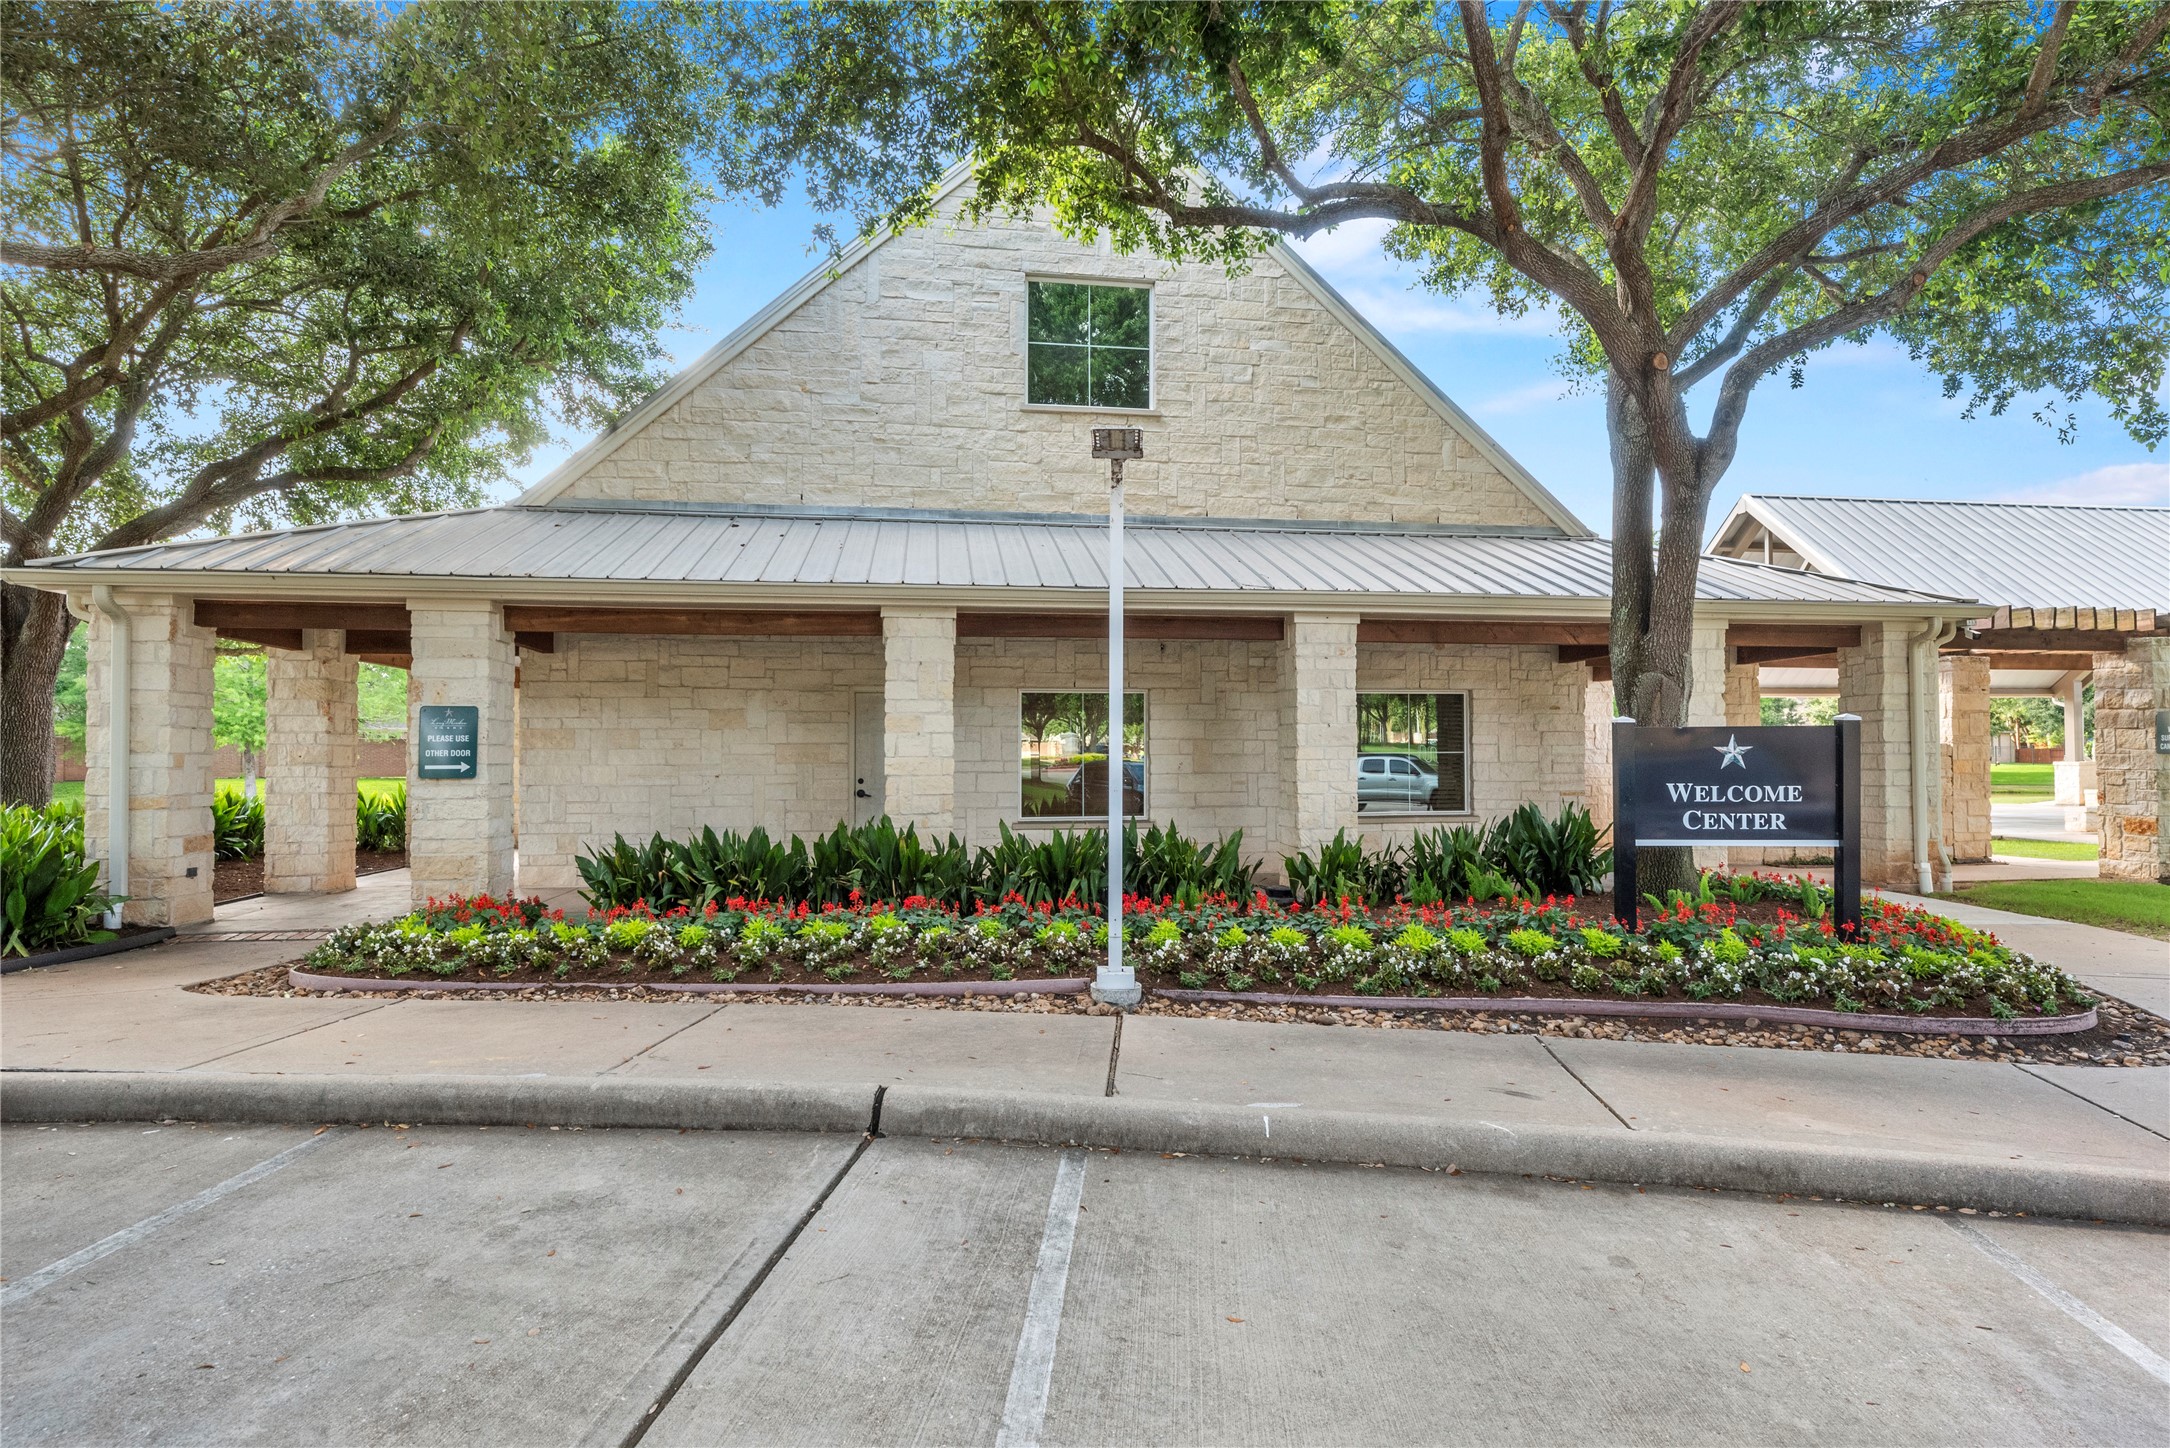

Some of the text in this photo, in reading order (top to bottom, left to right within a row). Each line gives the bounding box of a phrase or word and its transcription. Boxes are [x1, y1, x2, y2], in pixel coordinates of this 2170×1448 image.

[427, 734, 470, 742] PLEASE USE
[425, 749, 471, 757] OTHER DOOR
[1665, 782, 1803, 803] WELCOME
[1682, 809, 1787, 830] CENTER
